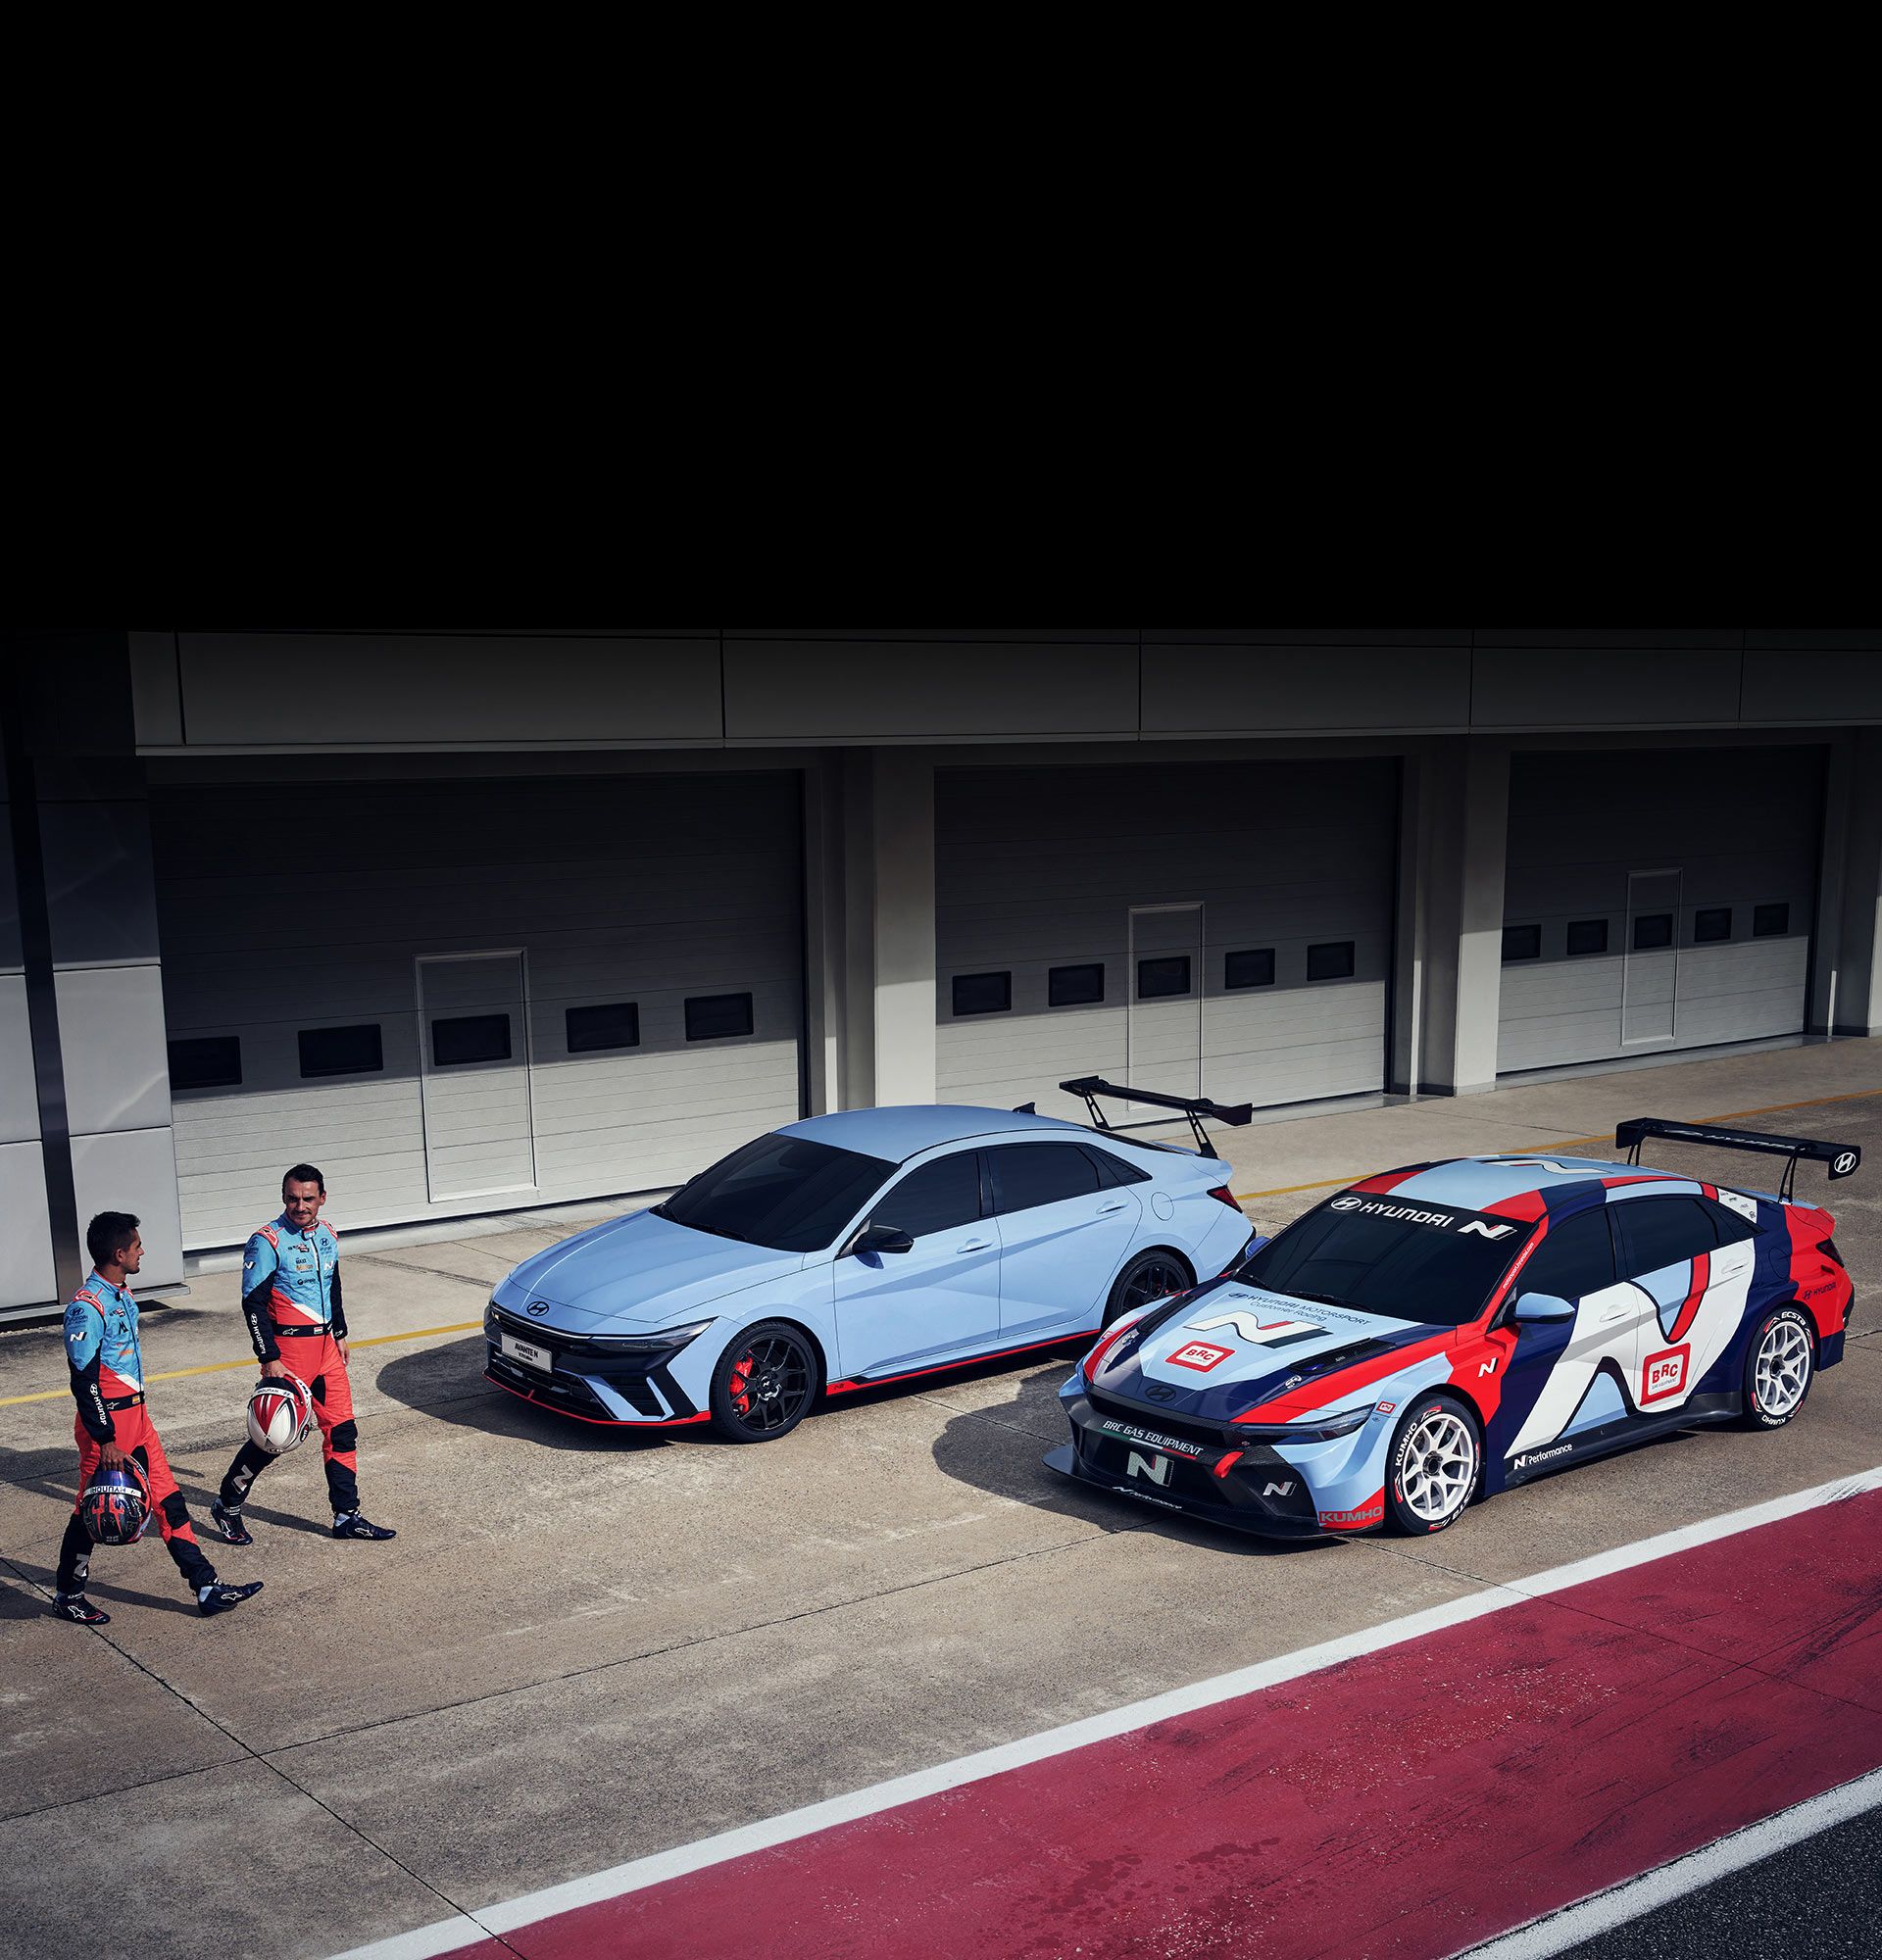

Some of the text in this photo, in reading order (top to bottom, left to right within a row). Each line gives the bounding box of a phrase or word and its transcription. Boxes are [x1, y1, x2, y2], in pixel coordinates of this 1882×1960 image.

[1359, 1201, 1455, 1228] HYUNDAI
[1247, 1295, 1372, 1325] HYUNDAI MOTORSPORT
[1250, 1300, 1296, 1314] Customer
[1185, 1348, 1214, 1360] BRC
[1652, 1363, 1678, 1384] BRC
[93, 1396, 108, 1426] HYUNDA
[1760, 1414, 1786, 1426] KUMHO
[1103, 1420, 1204, 1456] BRC GAS EQUIPMENT
[1395, 1422, 1418, 1467] KUMHO
[1529, 1444, 1572, 1465] Performance
[1320, 1506, 1382, 1522] KUMHO
